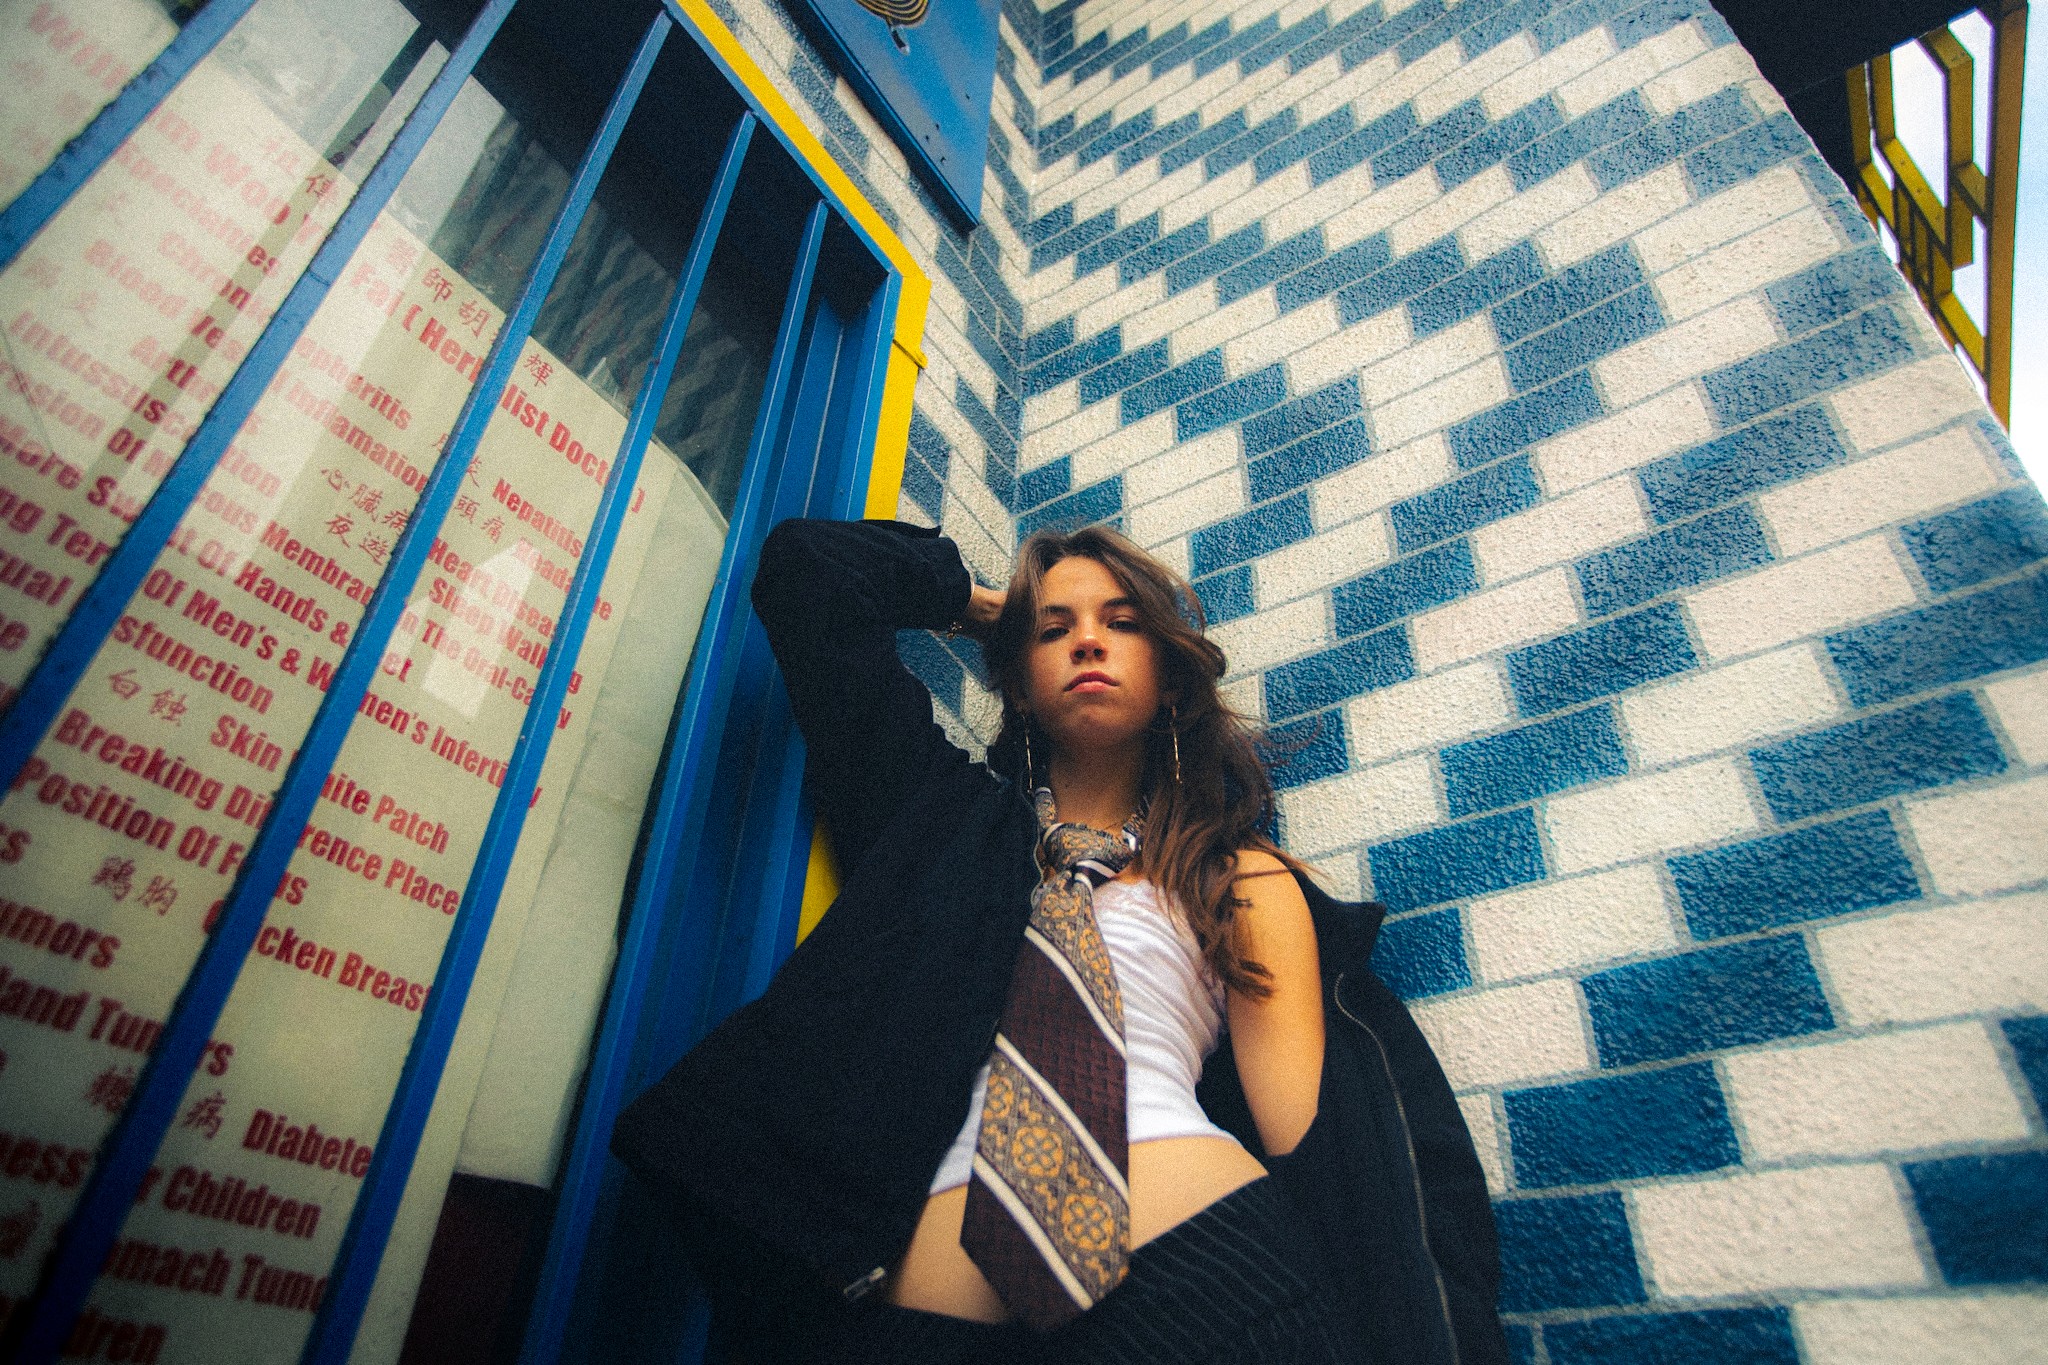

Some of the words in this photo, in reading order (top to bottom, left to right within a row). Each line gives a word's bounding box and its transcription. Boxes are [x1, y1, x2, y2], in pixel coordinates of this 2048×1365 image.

[29, 2, 202, 152] Willm
[418, 317, 551, 437] Herlist
[548, 421, 612, 488] Doct
[83, 238, 188, 319] Blood
[189, 307, 290, 393] Vesl
[9, 310, 283, 498] Intussusction
[131, 336, 262, 436] Arthrs
[295, 335, 411, 431] epheritis
[106, 427, 147, 463] Of
[142, 448, 260, 534] Mous
[260, 518, 375, 606] Membra
[421, 618, 462, 661] The
[463, 645, 572, 730] Oral-Cy
[198, 539, 239, 577] Of
[234, 560, 329, 632] Hands
[330, 620, 350, 649] &
[490, 577, 560, 641] Disea
[512, 537, 612, 621] Heade
[46, 512, 112, 566] Ter
[142, 568, 188, 607] Of
[182, 589, 279, 660] Men's
[279, 648, 301, 676] &
[306, 656, 429, 745] Wmen's
[430, 726, 543, 808] Inferti
[112, 614, 274, 714] sfunction
[428, 576, 498, 636] Sleep
[501, 620, 584, 694] Walg
[11, 756, 176, 851] Position
[178, 824, 222, 868] Of
[56, 707, 224, 811] Breaking
[224, 784, 383, 880] Difrence
[384, 858, 460, 916] Place
[211, 713, 283, 772] Skin
[373, 795, 450, 855] Patch
[203, 899, 337, 979] cken
[338, 951, 433, 1012] Breas
[243, 1108, 373, 1179] Diabete
[163, 1164, 322, 1238] Children
[104, 1240, 232, 1297] mach
[236, 1253, 328, 1313] Tum
